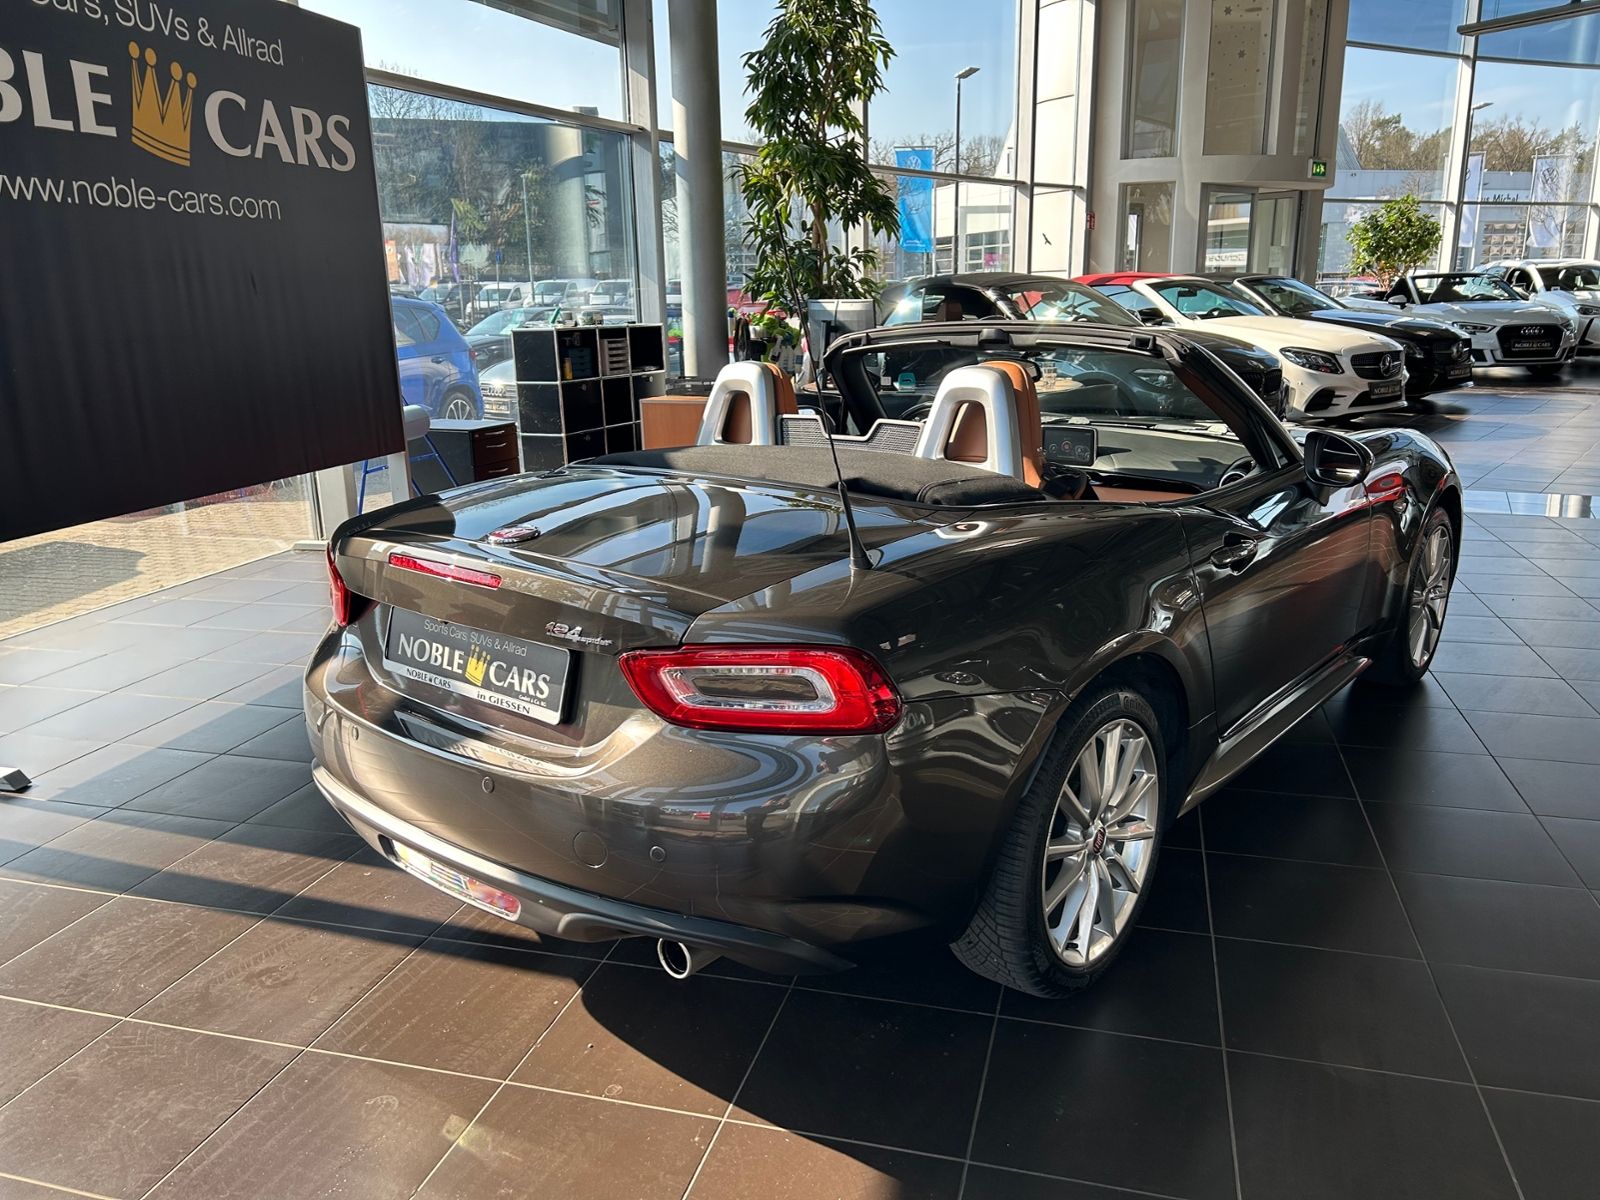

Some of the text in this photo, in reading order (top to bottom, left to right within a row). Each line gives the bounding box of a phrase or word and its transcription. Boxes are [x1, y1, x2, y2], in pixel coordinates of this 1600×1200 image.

[197, 17, 217, 49] &
[223, 24, 284, 66] Allrad
[204, 90, 356, 172] CARS
[0, 174, 282, 221] ww.noble-cars.com
[423, 619, 449, 636] Sports
[470, 631, 493, 648] SUVs
[493, 638, 501, 650] &
[502, 640, 528, 657] Allrad
[398, 632, 551, 699] NOBLE CARS
[406, 668, 452, 689] NOBLE CARS
[476, 690, 531, 715] in GIESSEN
